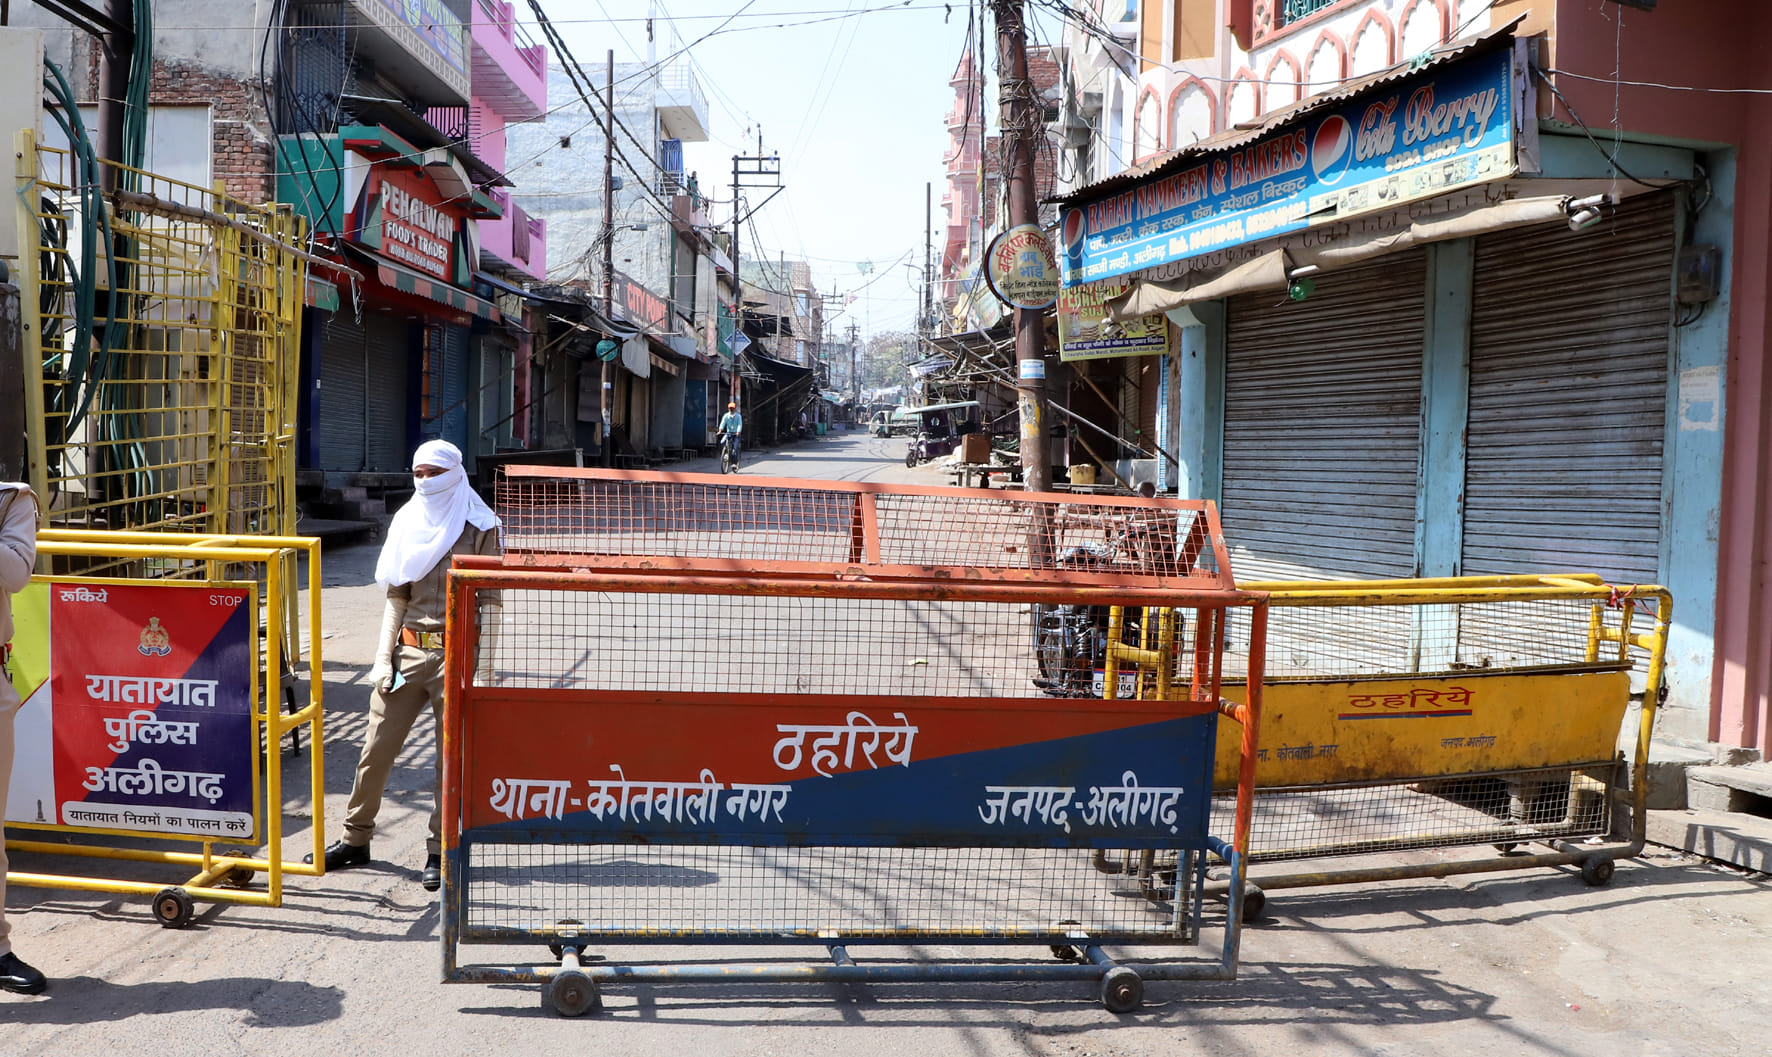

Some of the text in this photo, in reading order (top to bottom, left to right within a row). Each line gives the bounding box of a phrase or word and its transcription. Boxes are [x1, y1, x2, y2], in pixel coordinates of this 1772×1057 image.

[1355, 95, 1400, 162] Cola
[1402, 80, 1499, 148] Berry
[1385, 135, 1461, 173] SODA SHOP
[1088, 190, 1134, 235] RAHAT
[1136, 163, 1209, 220] NAMKEEN
[1211, 160, 1226, 196] &
[1230, 128, 1308, 190] BAKERS
[381, 180, 454, 243] PEHALWAN
[385, 220, 448, 264] FOOD'S TRADER
[627, 282, 646, 317] CITY
[209, 595, 242, 606] STOP
[85, 675, 218, 707] यातायात
[1348, 686, 1476, 709] ठहरिये
[104, 710, 199, 753] पुलिस
[773, 711, 919, 778] ठहरिये
[82, 758, 225, 804] अलीगढ़
[69, 809, 247, 832] यातायात नियमों का पालन करें
[726, 783, 792, 823] नगर
